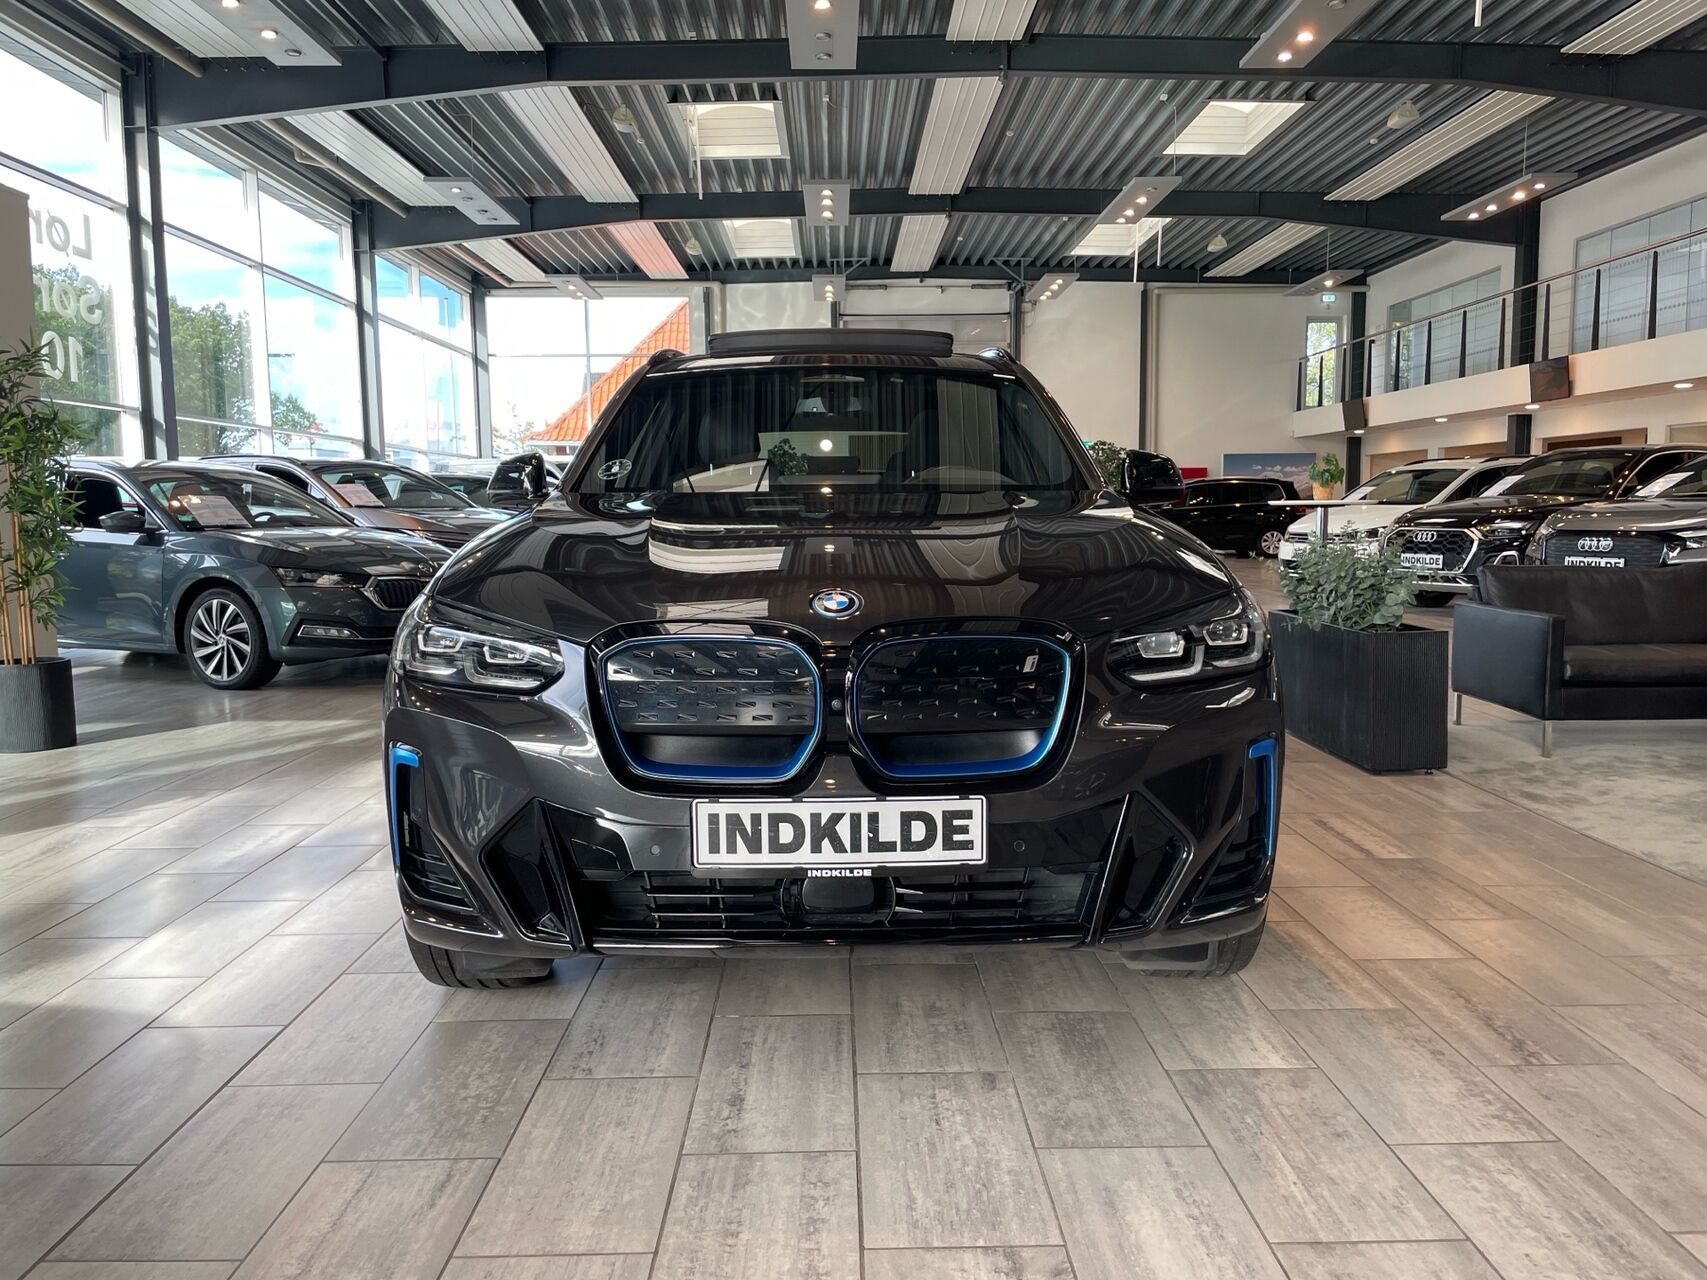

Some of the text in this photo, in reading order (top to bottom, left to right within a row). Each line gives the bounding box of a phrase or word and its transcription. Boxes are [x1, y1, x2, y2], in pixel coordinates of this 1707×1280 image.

[1402, 556, 1441, 566] INDKILDE
[707, 809, 974, 855] INDKILDE
[807, 868, 873, 878] INDKILDE
